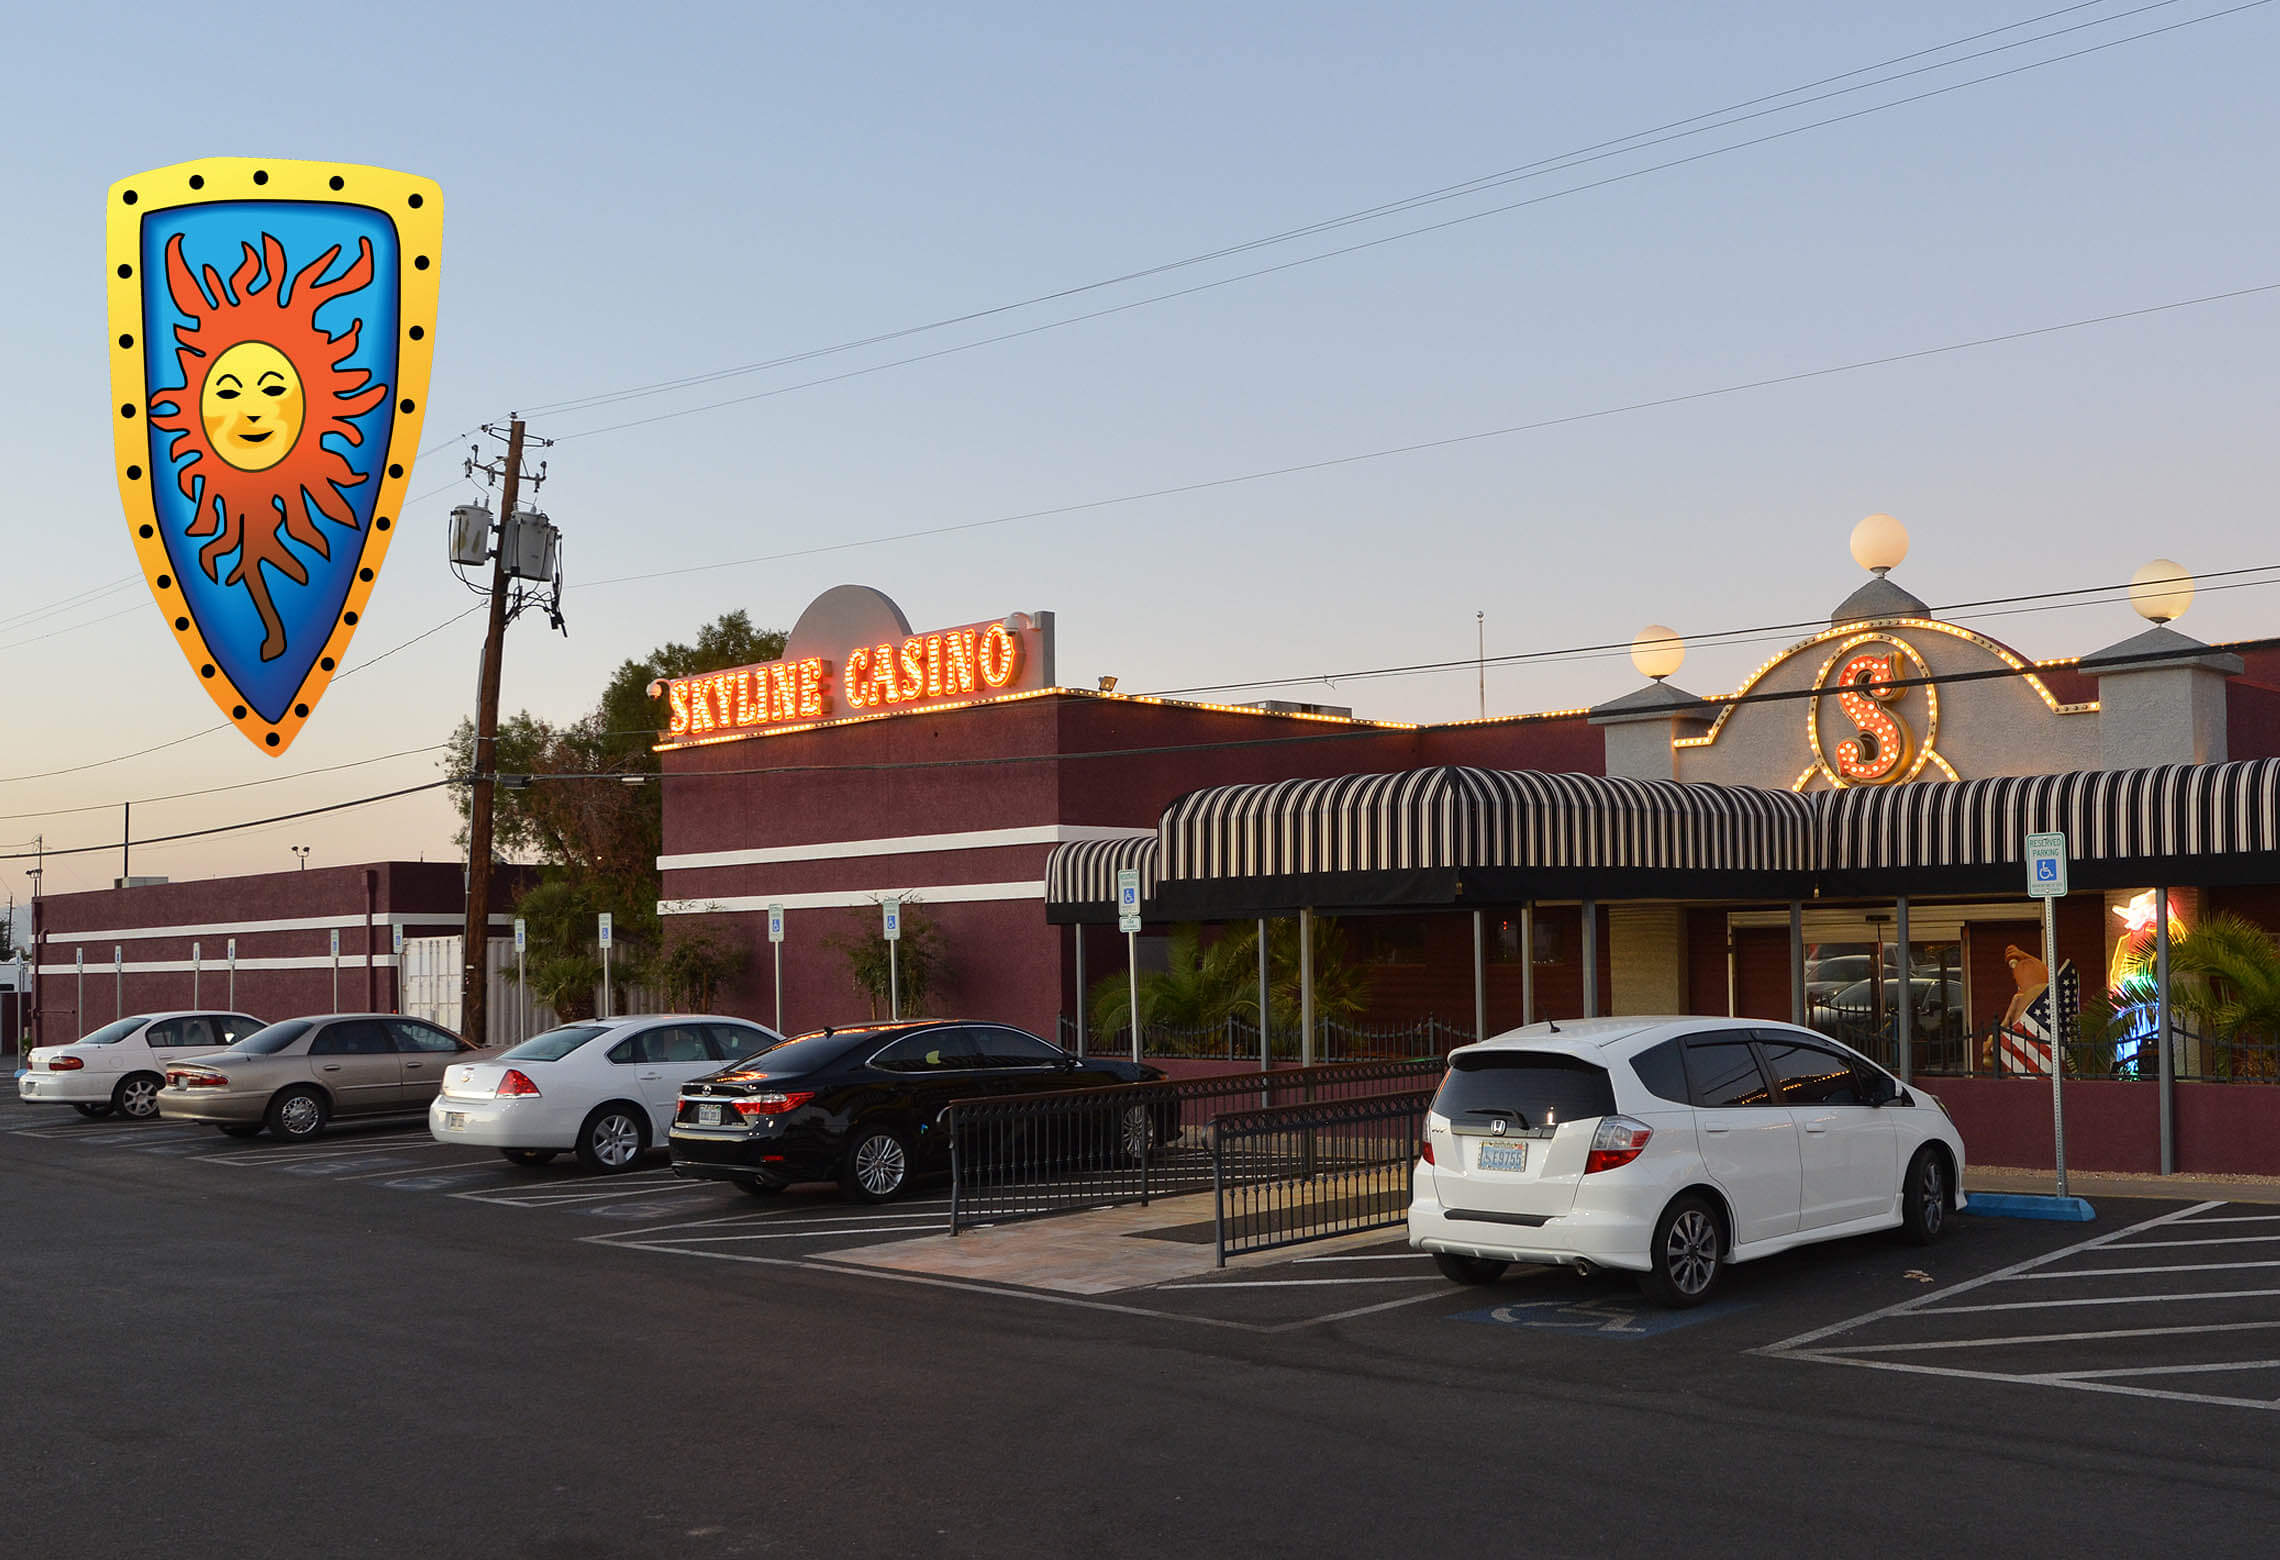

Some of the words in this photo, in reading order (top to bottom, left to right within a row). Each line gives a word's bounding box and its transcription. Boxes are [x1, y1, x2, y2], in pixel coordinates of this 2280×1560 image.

[669, 656, 822, 737] SKYLINE
[845, 623, 1017, 709] CASINO
[1836, 654, 1903, 781] S
[2029, 838, 2062, 848] RESERVED
[2032, 848, 2060, 856] PARKING
